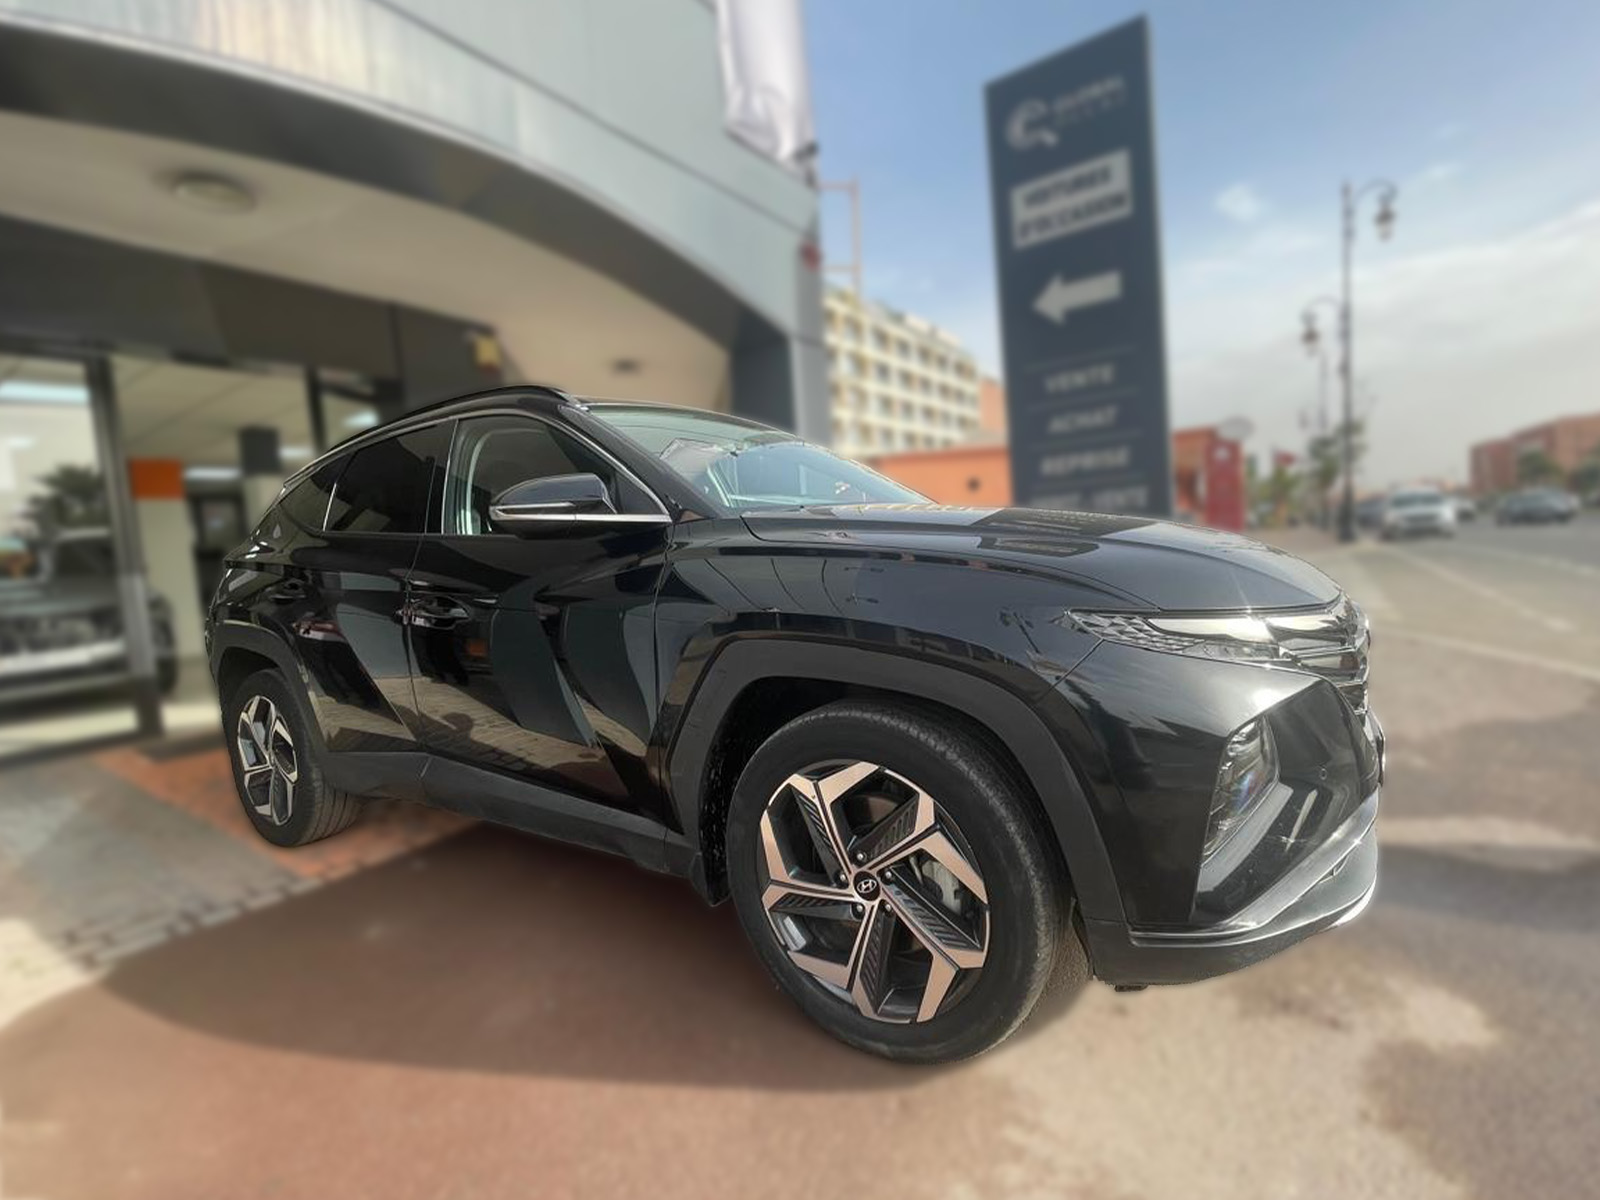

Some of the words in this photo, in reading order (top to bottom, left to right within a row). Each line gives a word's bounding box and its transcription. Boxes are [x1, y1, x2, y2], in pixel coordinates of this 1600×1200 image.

[1024, 166, 1111, 208] VOITURES
[1044, 362, 1115, 393] VENTE
[1047, 404, 1119, 433] ACHAT
[1040, 445, 1131, 476] REPRISE
